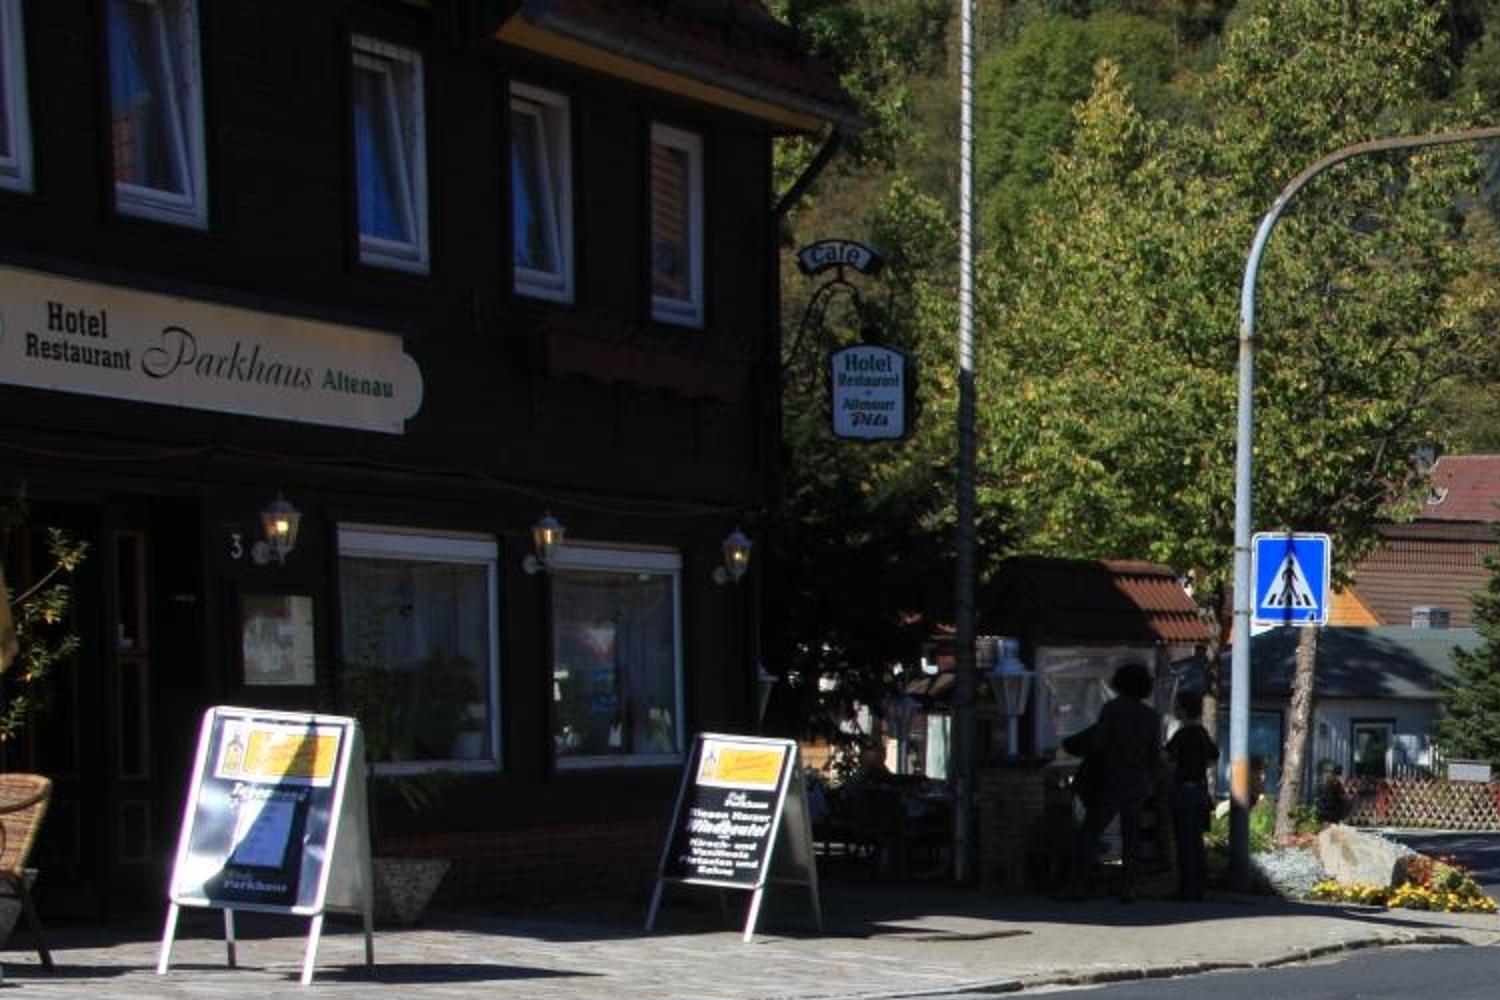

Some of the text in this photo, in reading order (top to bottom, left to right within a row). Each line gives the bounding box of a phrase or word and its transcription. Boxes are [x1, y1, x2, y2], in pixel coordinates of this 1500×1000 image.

[47, 301, 109, 339] Hotel
[25, 325, 394, 399] Restaurant Parkhaus Altenau
[844, 353, 893, 373] Hotel
[230, 533, 244, 560] 3
